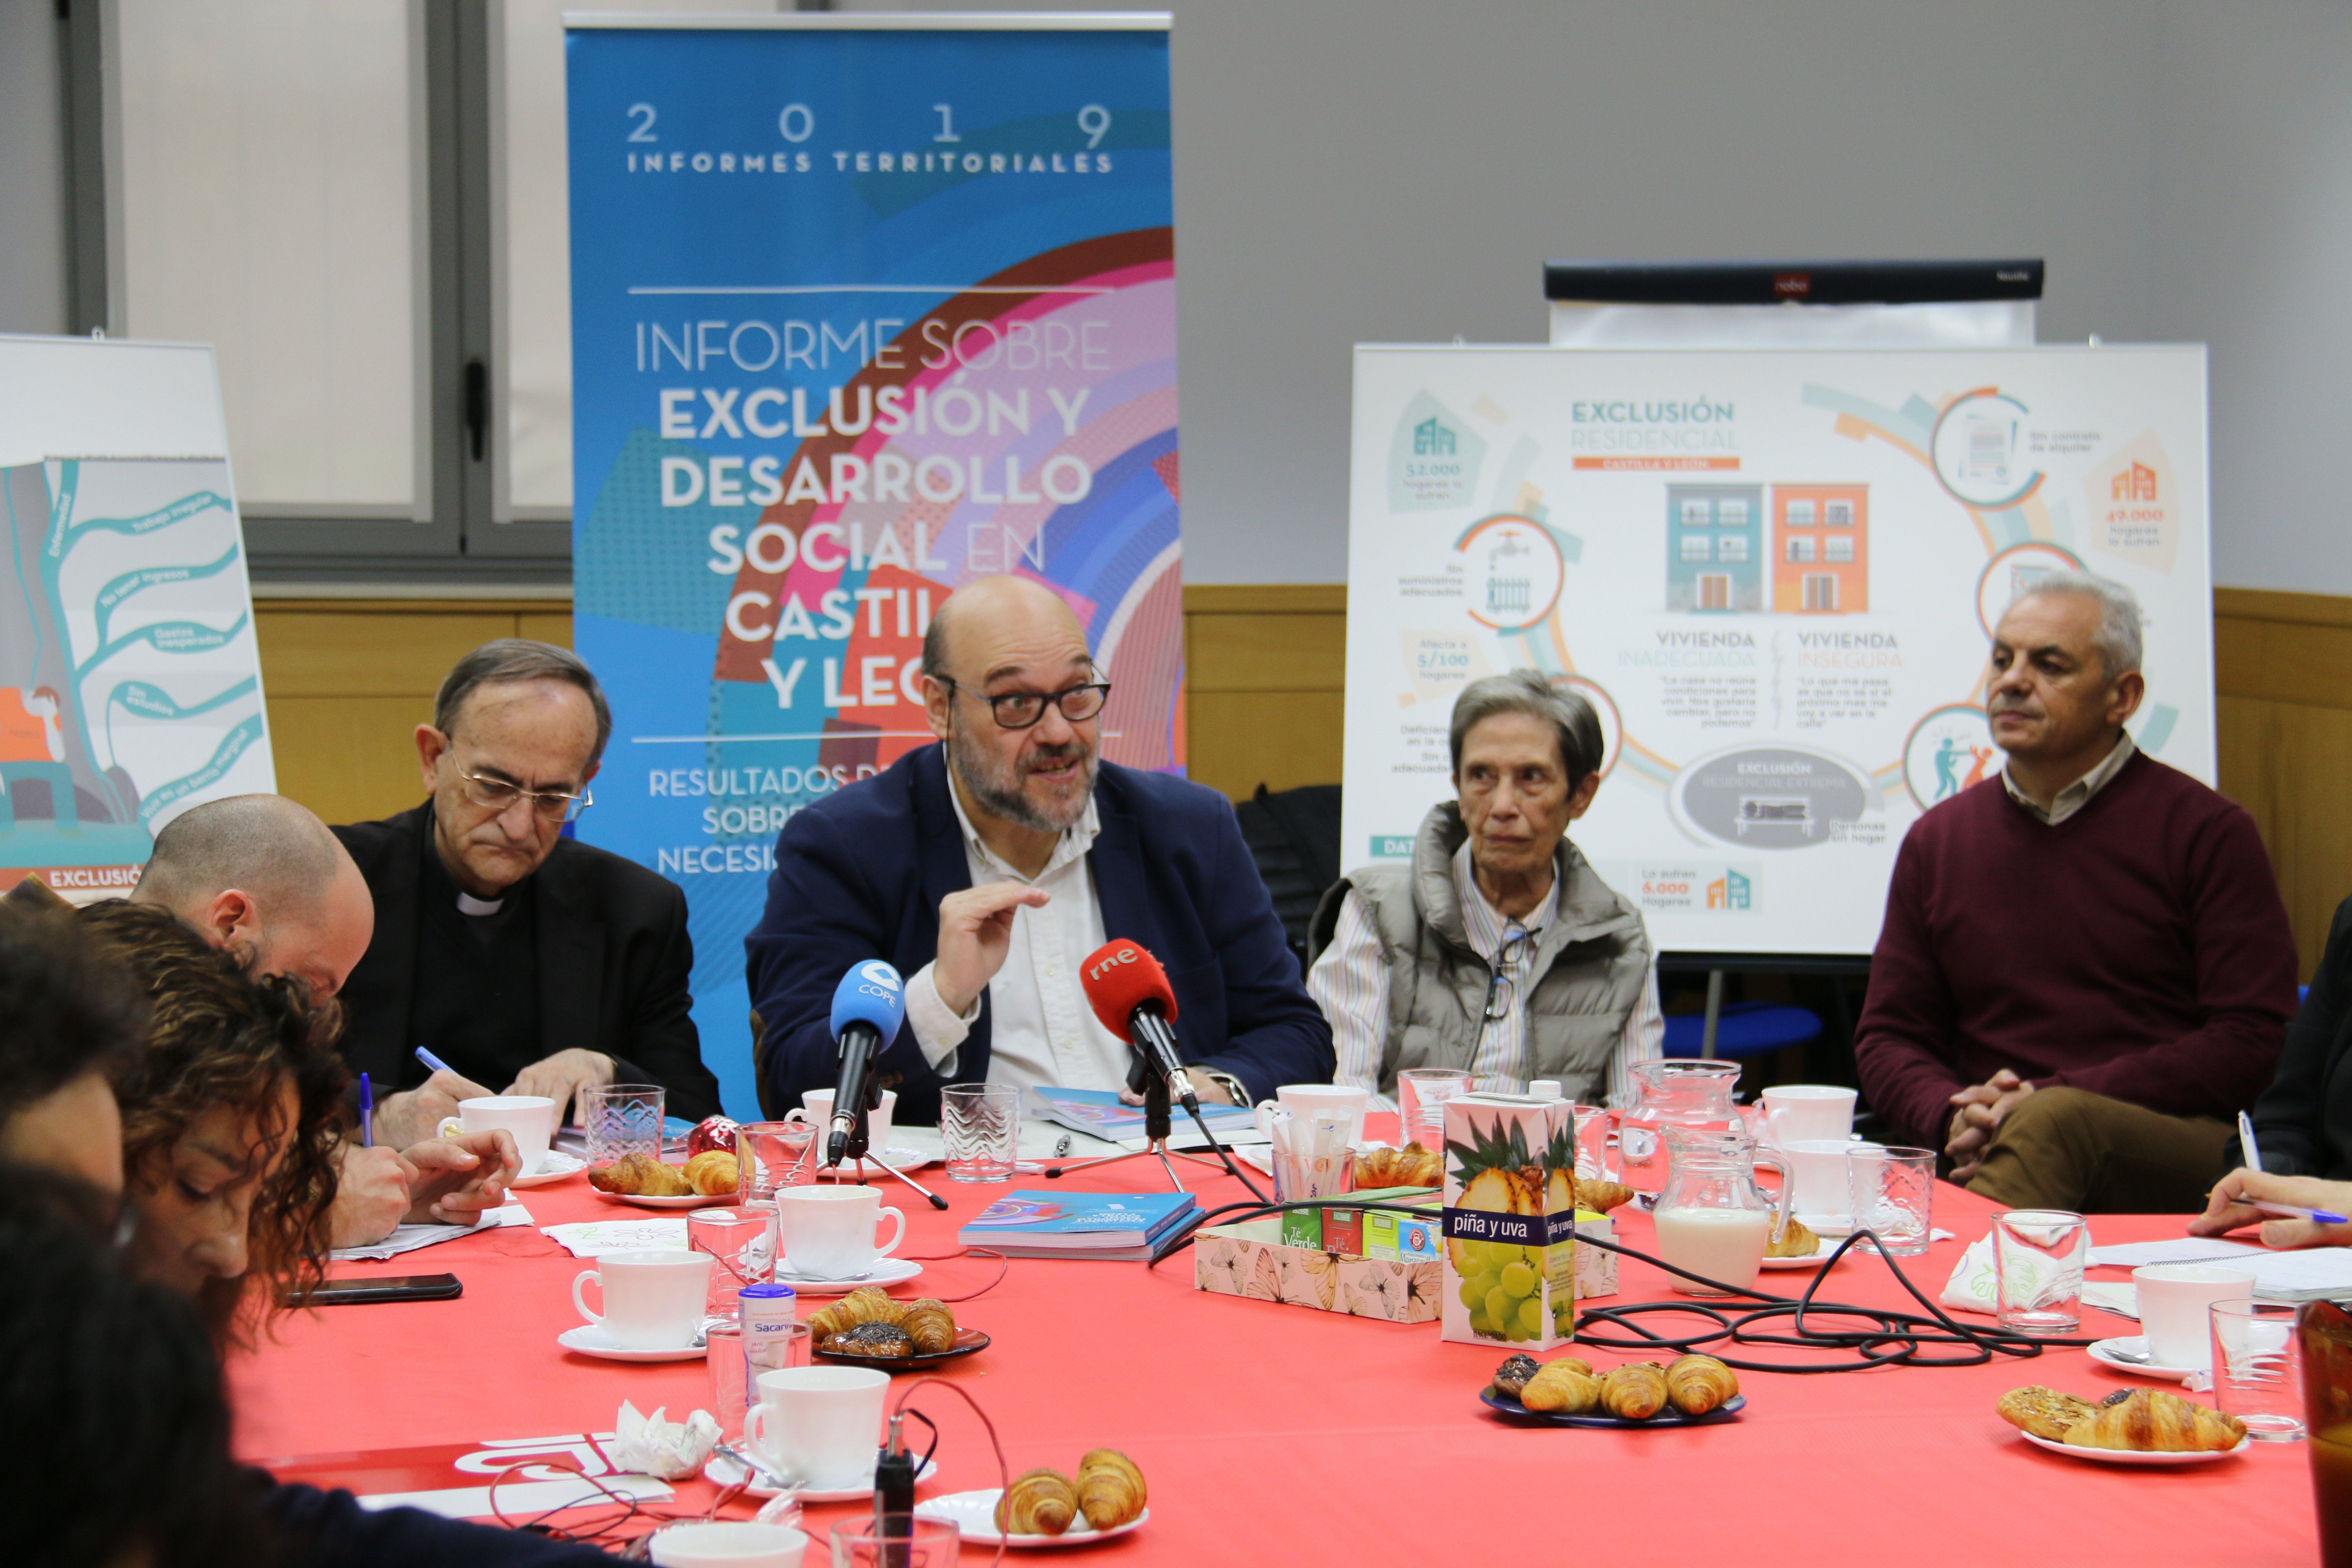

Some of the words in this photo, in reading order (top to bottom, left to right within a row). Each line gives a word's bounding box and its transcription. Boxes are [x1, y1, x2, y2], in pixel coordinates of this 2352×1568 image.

[627, 152, 812, 173] INFORMES
[833, 152, 1113, 173] TERRITORIALES
[634, 320, 904, 371] INFORME
[920, 319, 1112, 371] SOBRE
[660, 372, 1031, 438] EXCLUSIÓN
[1046, 387, 1091, 437] Y
[1571, 395, 1733, 423] EXCLUSIÓN
[1571, 429, 1741, 450] RESIDENCIAL
[2029, 431, 2049, 441] Sin
[2052, 431, 2102, 441] contrato
[2029, 443, 2046, 453] de
[2048, 443, 2093, 455] alquiler
[1603, 459, 1660, 470] CASTILLA
[1661, 459, 1672, 470] Y
[1673, 456, 1709, 470] LEÓN
[660, 455, 1093, 507] DESARROLLO
[1403, 480, 1450, 492] hogares
[1415, 491, 1450, 501] sufren
[132, 512, 171, 533] Trabajo
[2105, 509, 2164, 522] 49.000
[48, 491, 71, 558] Enfermedad
[2110, 526, 2159, 539] hogares
[707, 523, 949, 575] SOCIAL
[967, 523, 1046, 572] EN
[2108, 537, 2119, 547] lo
[2123, 537, 2160, 547] sufren
[1398, 576, 1464, 585] suministros
[100, 592, 117, 607] No
[114, 575, 140, 597] tener
[1400, 587, 1464, 597] adecuados
[154, 628, 194, 639] Gastos
[1655, 632, 1756, 648] VIVIENDA
[1797, 632, 1900, 648] VIVIENDA
[1419, 639, 1456, 649] Afecta
[1418, 649, 1469, 668] 5/100
[1617, 649, 1755, 668] INADECUADA
[1797, 650, 1905, 668] INSEGURA
[760, 658, 808, 709] Y
[1419, 670, 1466, 682] hogares
[128, 686, 146, 699] Sin
[1664, 687, 1729, 695] condiciones
[1732, 688, 1757, 698] para
[126, 695, 174, 716] estudios
[1400, 724, 1450, 734] Deficien
[1392, 763, 1450, 773] adecuada
[1737, 760, 1813, 775] EXCLUSIÓN
[649, 765, 848, 797] RESULTADOS
[857, 763, 892, 781] D
[658, 844, 778, 874] NECESI
[1642, 869, 1657, 878] Lo
[1660, 869, 1697, 879] sufren
[1642, 880, 1690, 894] 6.000
[1642, 897, 1692, 909] Hogares
[1089, 948, 1138, 981] rne
[858, 984, 896, 1008] COPE
[1291, 1226, 1301, 1238] Té
[1454, 1213, 1485, 1234] piña
[1489, 1220, 1498, 1237] y
[1501, 1221, 1527, 1237] uva
[1547, 1222, 1558, 1237] piña
[1562, 1219, 1573, 1230] uva
[1283, 1233, 1317, 1250] Verde
[1334, 1237, 1345, 1250] Té
[1399, 1253, 1431, 1263] Manzanill
[1473, 1330, 1507, 1341] HACENDADO
